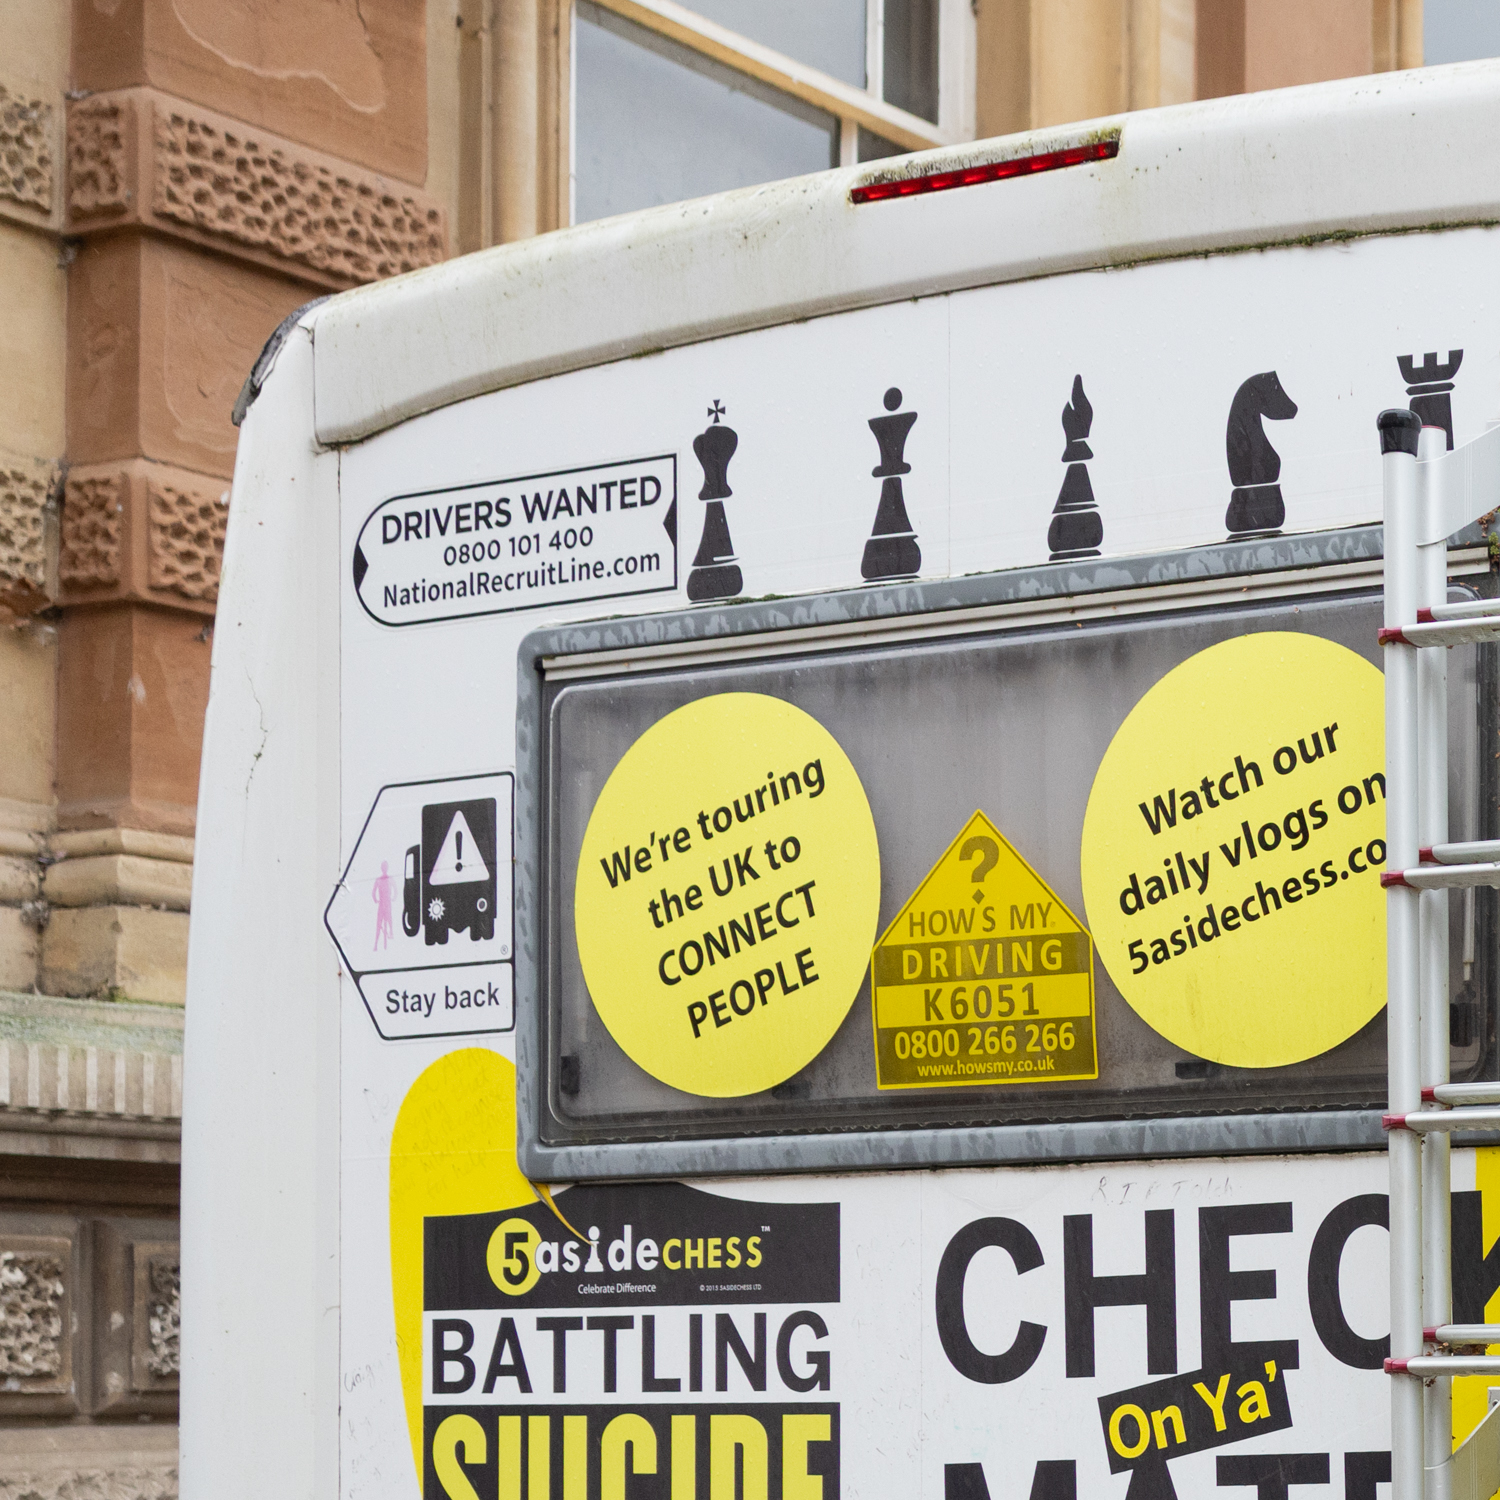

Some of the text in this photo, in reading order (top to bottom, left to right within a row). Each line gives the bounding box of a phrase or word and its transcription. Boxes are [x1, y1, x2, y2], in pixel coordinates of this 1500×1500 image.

[381, 475, 662, 546] DRIVERS WANTED
[443, 525, 593, 566] 0800 101 400
[382, 551, 661, 608] NationalRecruitLine.com
[696, 758, 828, 842] touring
[1138, 722, 1340, 835] Watch our
[1118, 770, 1386, 916] daily vlogs on
[648, 836, 802, 930] the UK to
[1127, 836, 1387, 976] 5asidechess.co
[658, 881, 818, 986] CONNECT
[1010, 902, 1051, 931] MY
[902, 939, 1063, 980] DRIVING
[384, 982, 500, 1017] Stay back
[687, 948, 820, 1040] PEOPLE
[924, 982, 1040, 1022] K6051
[894, 1022, 1075, 1060] 0800 266 266
[917, 1055, 1055, 1077] www.howsmy.co.uk
[578, 1283, 657, 1295] Celebrate Difference
[706, 1284, 719, 1292] 2015
[753, 1283, 762, 1291] LTD
[431, 1310, 831, 1395] BATTLING
[1108, 1401, 1189, 1460] On
